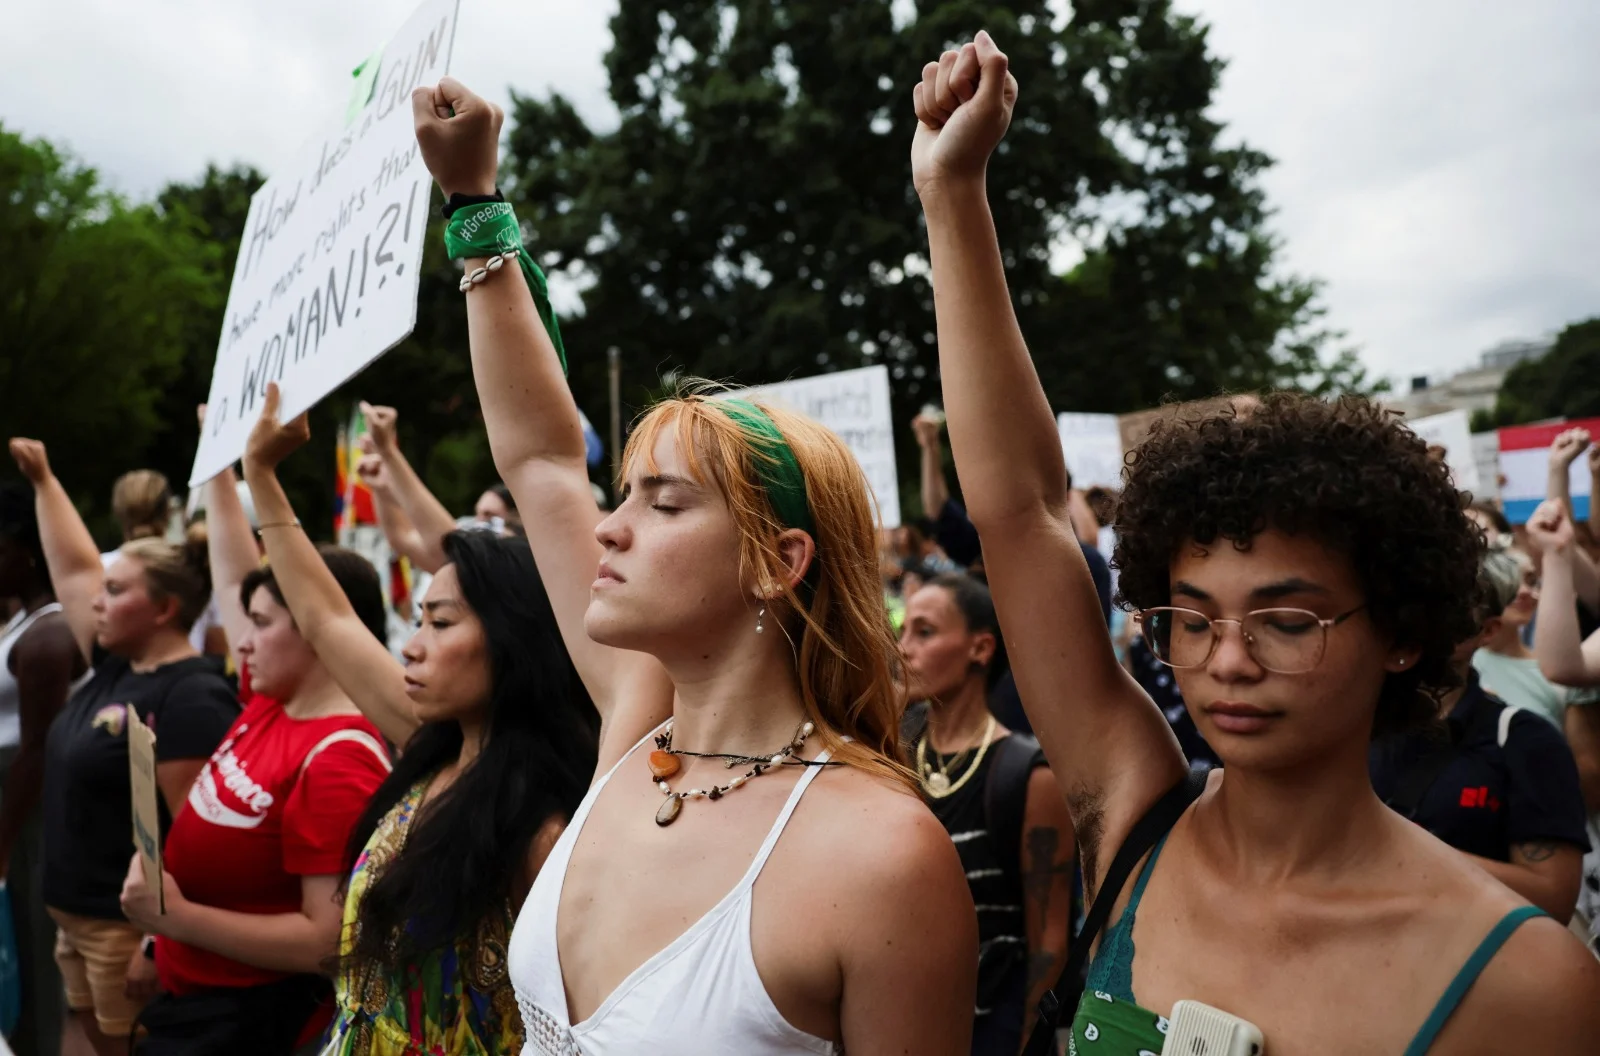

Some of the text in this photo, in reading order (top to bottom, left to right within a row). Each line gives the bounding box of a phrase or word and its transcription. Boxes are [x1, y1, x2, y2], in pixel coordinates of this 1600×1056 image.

[242, 180, 303, 281] How
[310, 131, 353, 195] does
[377, 15, 448, 122] GUN
[226, 300, 262, 351] have
[269, 250, 306, 308] more
[312, 187, 366, 261] rights
